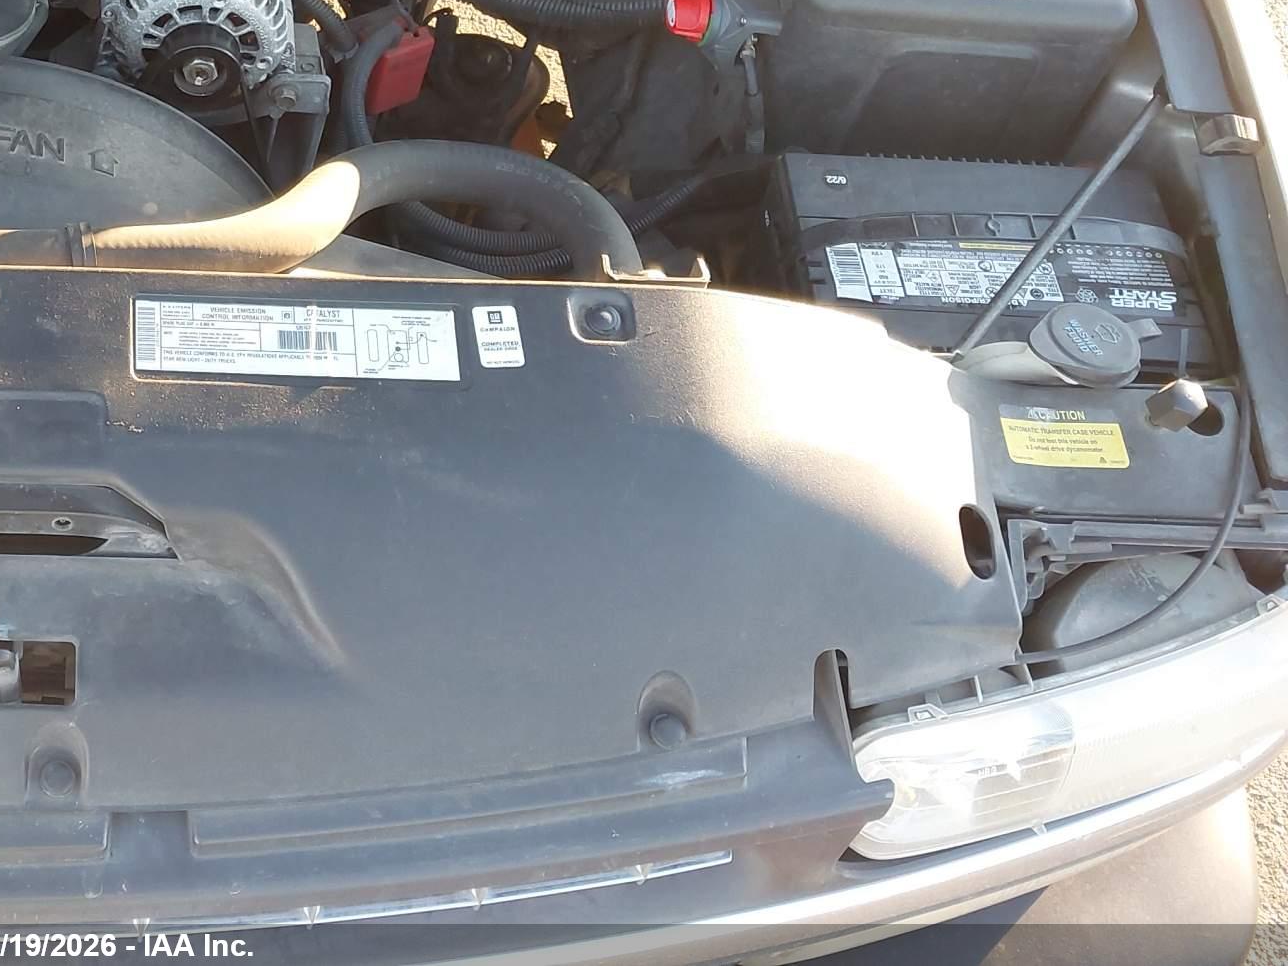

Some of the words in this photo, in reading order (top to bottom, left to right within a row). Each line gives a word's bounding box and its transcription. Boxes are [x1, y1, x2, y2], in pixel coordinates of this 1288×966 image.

[1109, 288, 1177, 302] START
[1111, 299, 1173, 311] SUPER
[1068, 316, 1104, 356] WASHER
[1038, 409, 1086, 421] CAUTION
